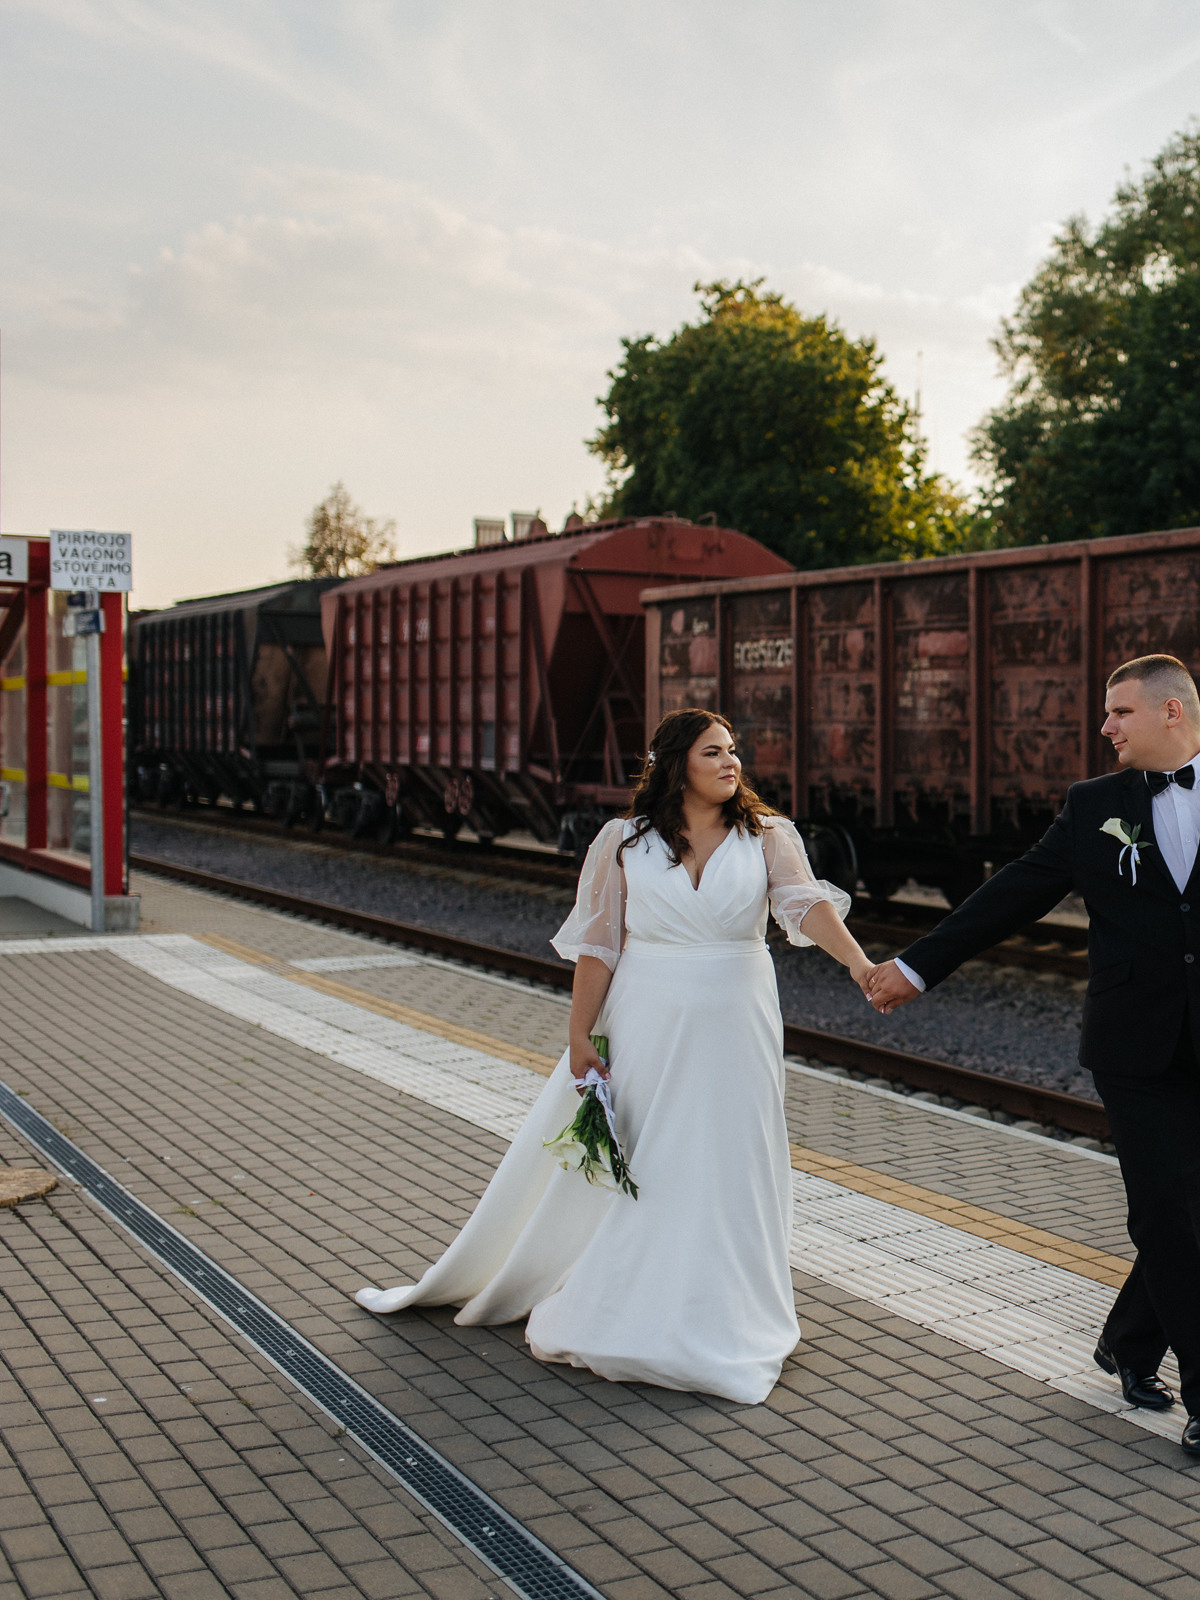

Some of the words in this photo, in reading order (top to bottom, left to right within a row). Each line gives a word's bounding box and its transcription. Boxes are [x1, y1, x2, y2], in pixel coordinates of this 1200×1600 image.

[57, 533, 127, 547] PIRMOJO
[59, 548, 126, 561] VAGONO
[70, 575, 116, 587] VIETA
